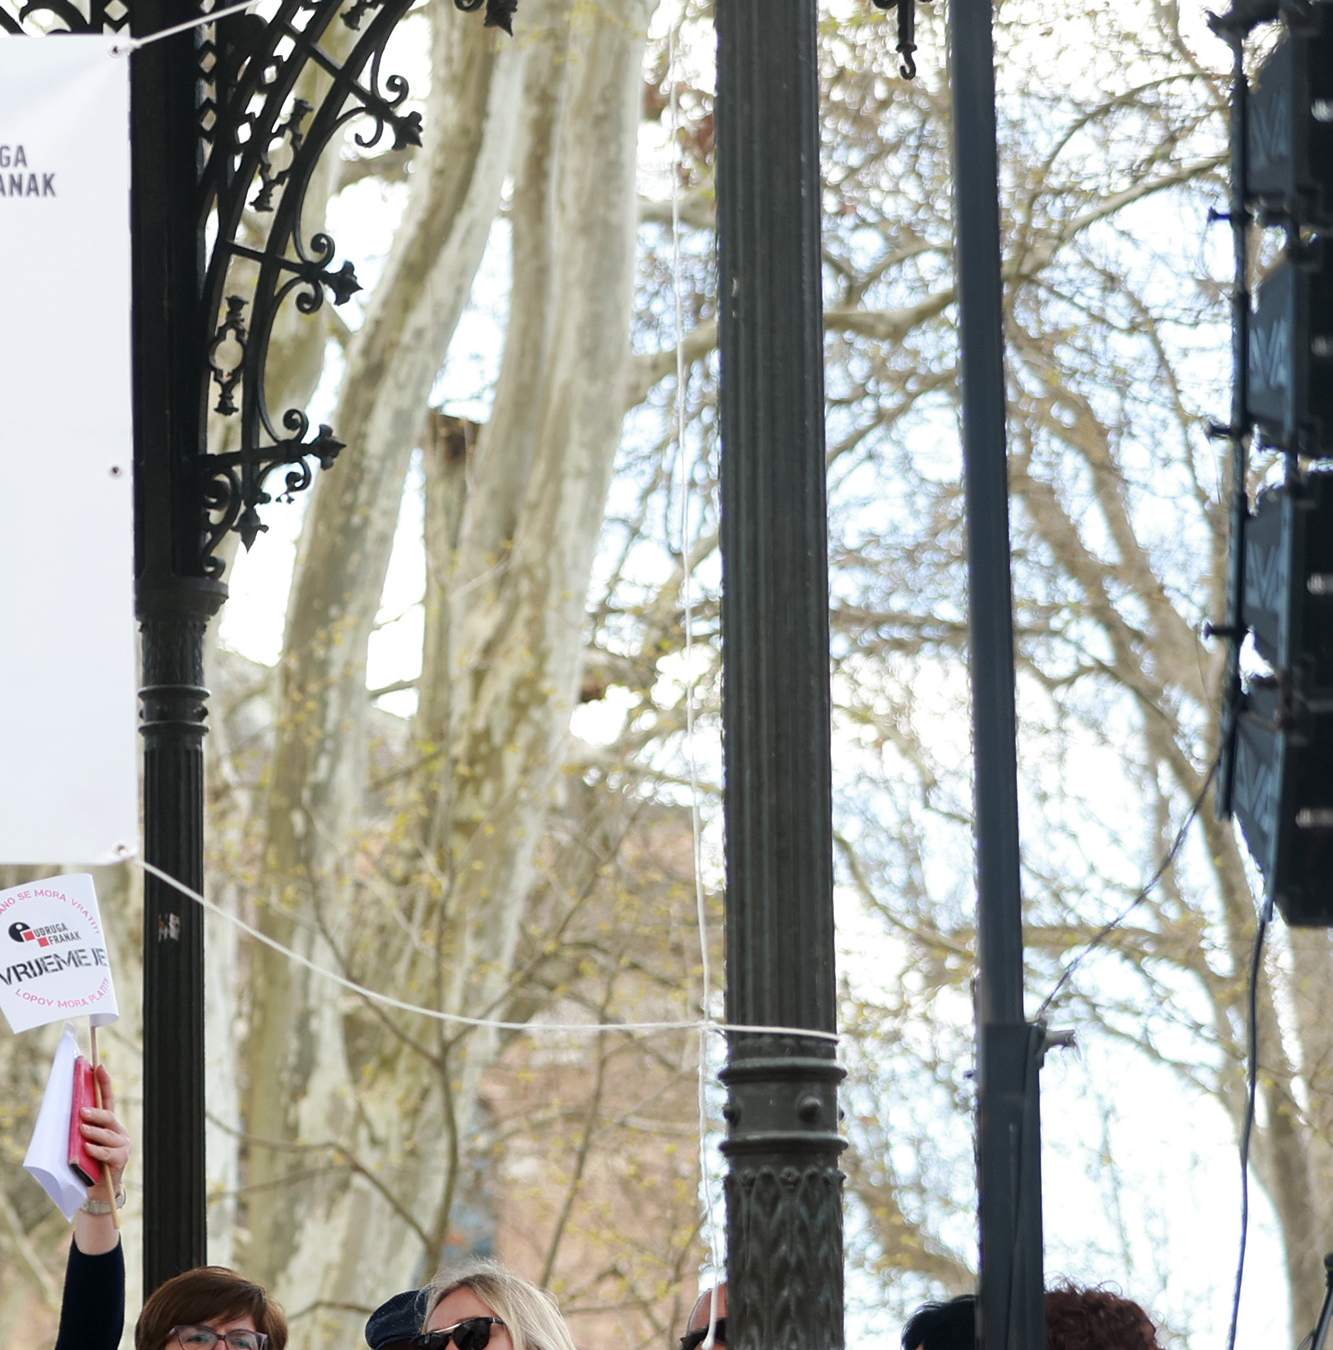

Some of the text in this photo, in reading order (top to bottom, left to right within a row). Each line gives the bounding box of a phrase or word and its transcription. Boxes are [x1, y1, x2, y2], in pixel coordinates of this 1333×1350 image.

[34, 889, 67, 902] MORA
[33, 922, 68, 938] UDRUGA
[48, 930, 82, 945] FRANAK
[14, 987, 55, 1007] LOPOV
[57, 998, 89, 1008] MORA
